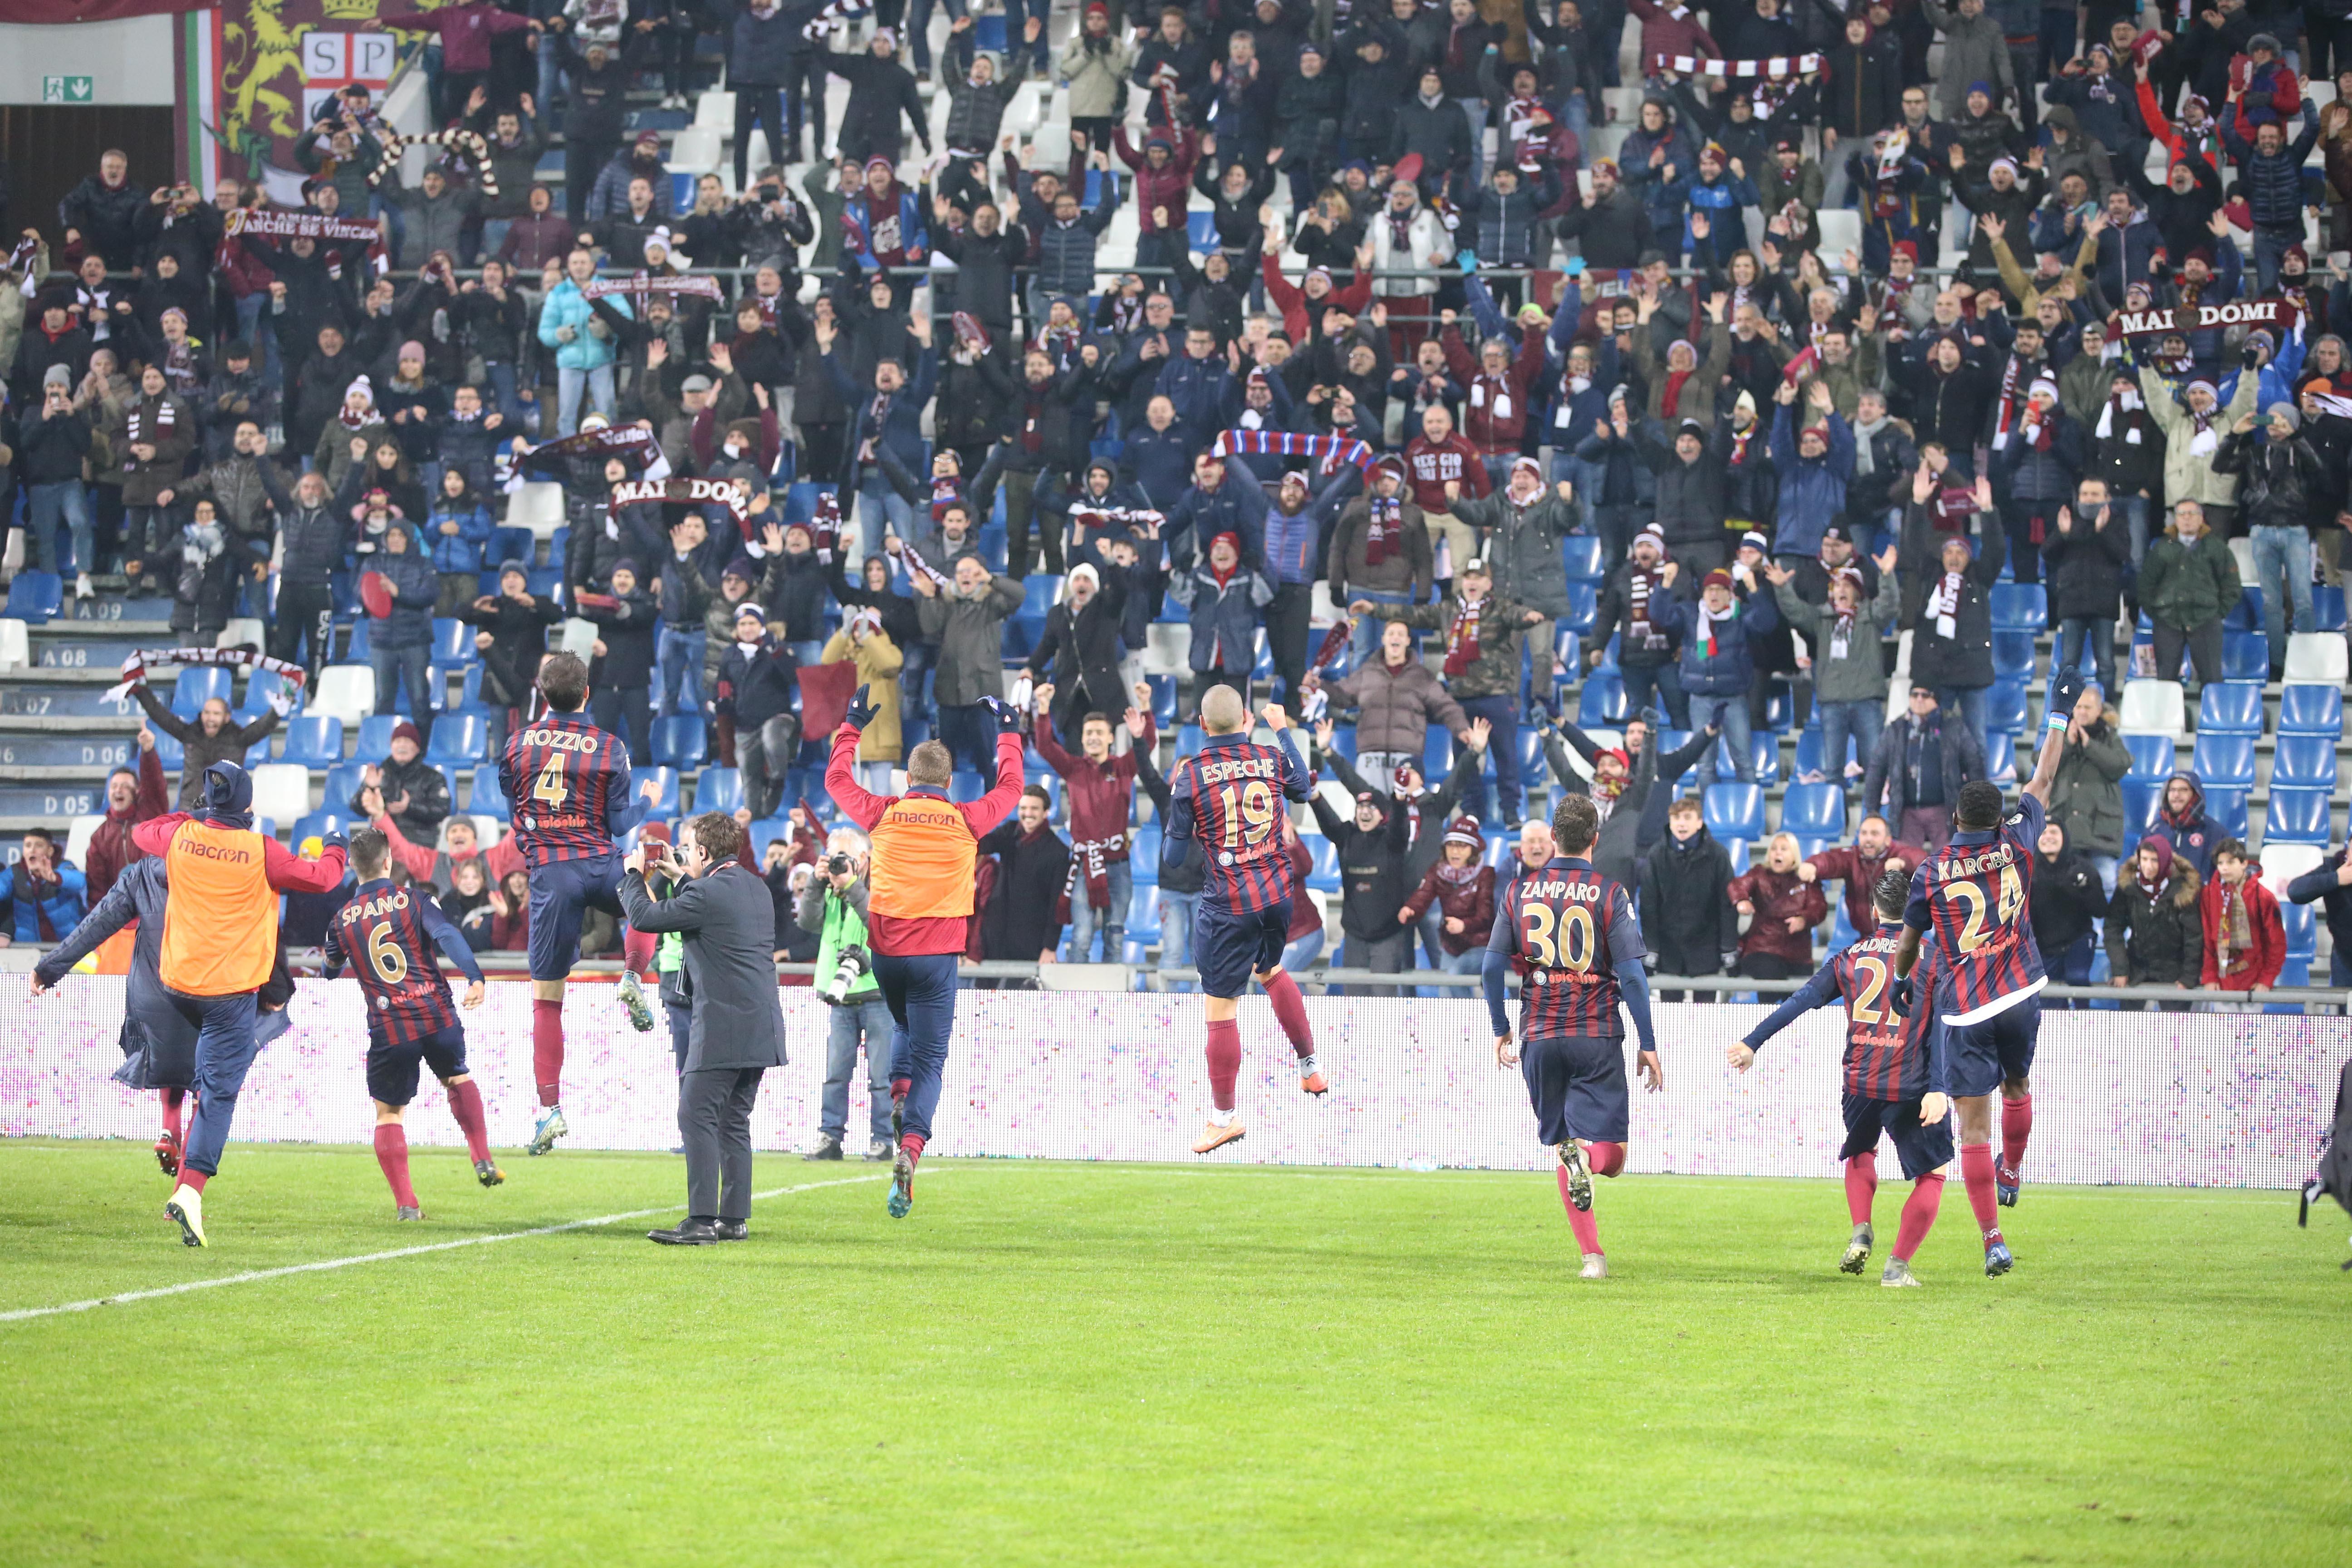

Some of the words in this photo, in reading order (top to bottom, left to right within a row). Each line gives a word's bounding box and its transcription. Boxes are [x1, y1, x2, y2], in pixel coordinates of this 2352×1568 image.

[314, 40, 336, 74] S
[362, 41, 385, 73] P
[2119, 309, 2175, 334] MAI
[2199, 302, 2278, 326] DOMI
[615, 479, 666, 505] MAI
[79, 603, 91, 619] A
[98, 602, 122, 620] 09
[44, 649, 56, 666] A
[61, 649, 88, 667] 08
[26, 696, 51, 715] 07
[522, 729, 598, 754] ROZZIO
[82, 746, 95, 764] D
[101, 746, 127, 764] 06
[533, 752, 568, 811] 4
[1200, 759, 1274, 784] ESPECHE
[44, 796, 58, 814] D
[64, 795, 89, 814] 05
[1220, 781, 1274, 848] 19
[892, 812, 955, 826] macron
[178, 838, 249, 864] macron
[1937, 843, 2014, 882] KARGBO
[1520, 881, 1600, 902] ZAMPARO
[342, 891, 409, 927] SPANÒ
[1943, 863, 2026, 953] 24
[1522, 902, 1595, 973] 30
[368, 921, 407, 984] 6
